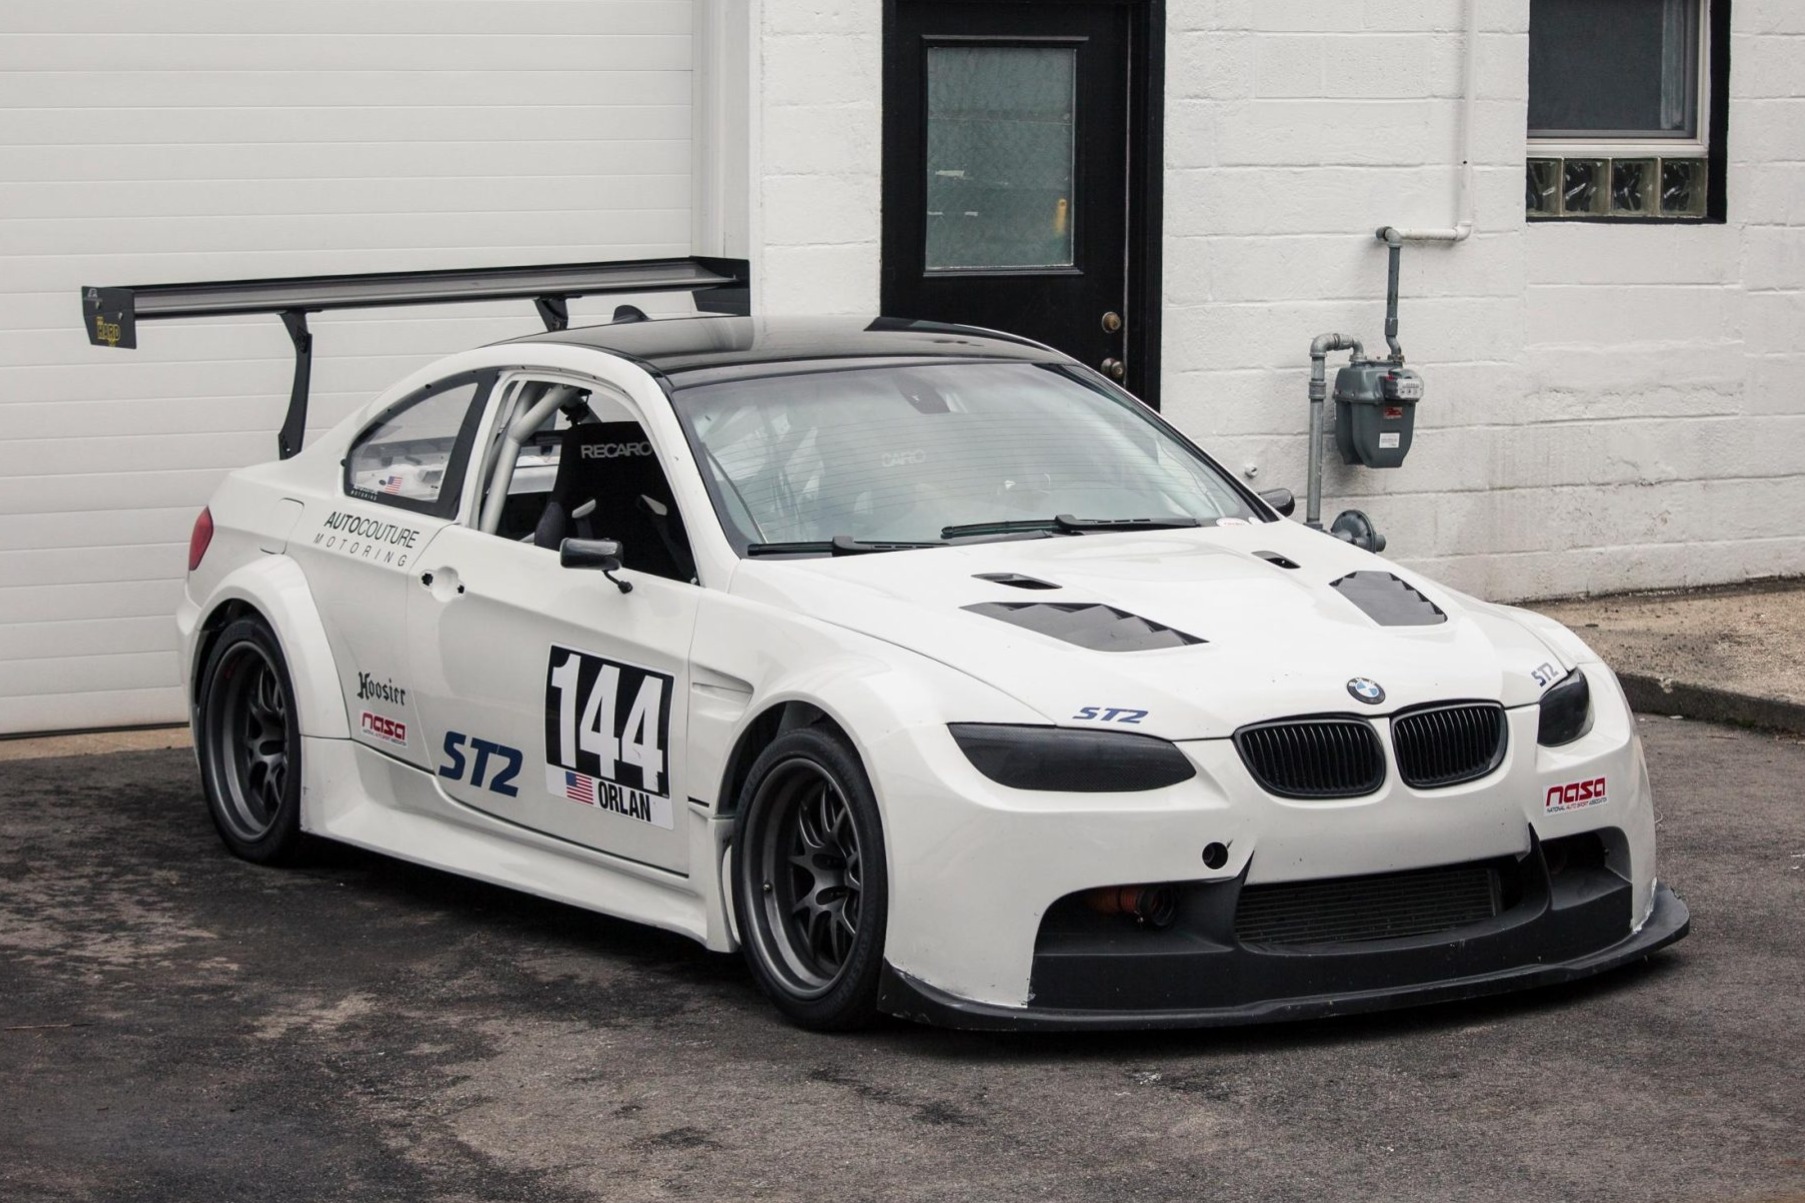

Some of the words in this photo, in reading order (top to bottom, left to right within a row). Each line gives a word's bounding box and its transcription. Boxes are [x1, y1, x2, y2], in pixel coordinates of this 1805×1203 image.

[581, 441, 653, 459] RECARO
[323, 511, 420, 548] AUTOCOUTURE
[313, 533, 407, 567] MOTORING
[357, 671, 406, 706] Hoosier
[1531, 662, 1559, 687] ST2
[551, 653, 664, 793] 144
[1072, 706, 1149, 724] ST2
[438, 731, 523, 798] ST2
[598, 781, 652, 822] ORLAN
